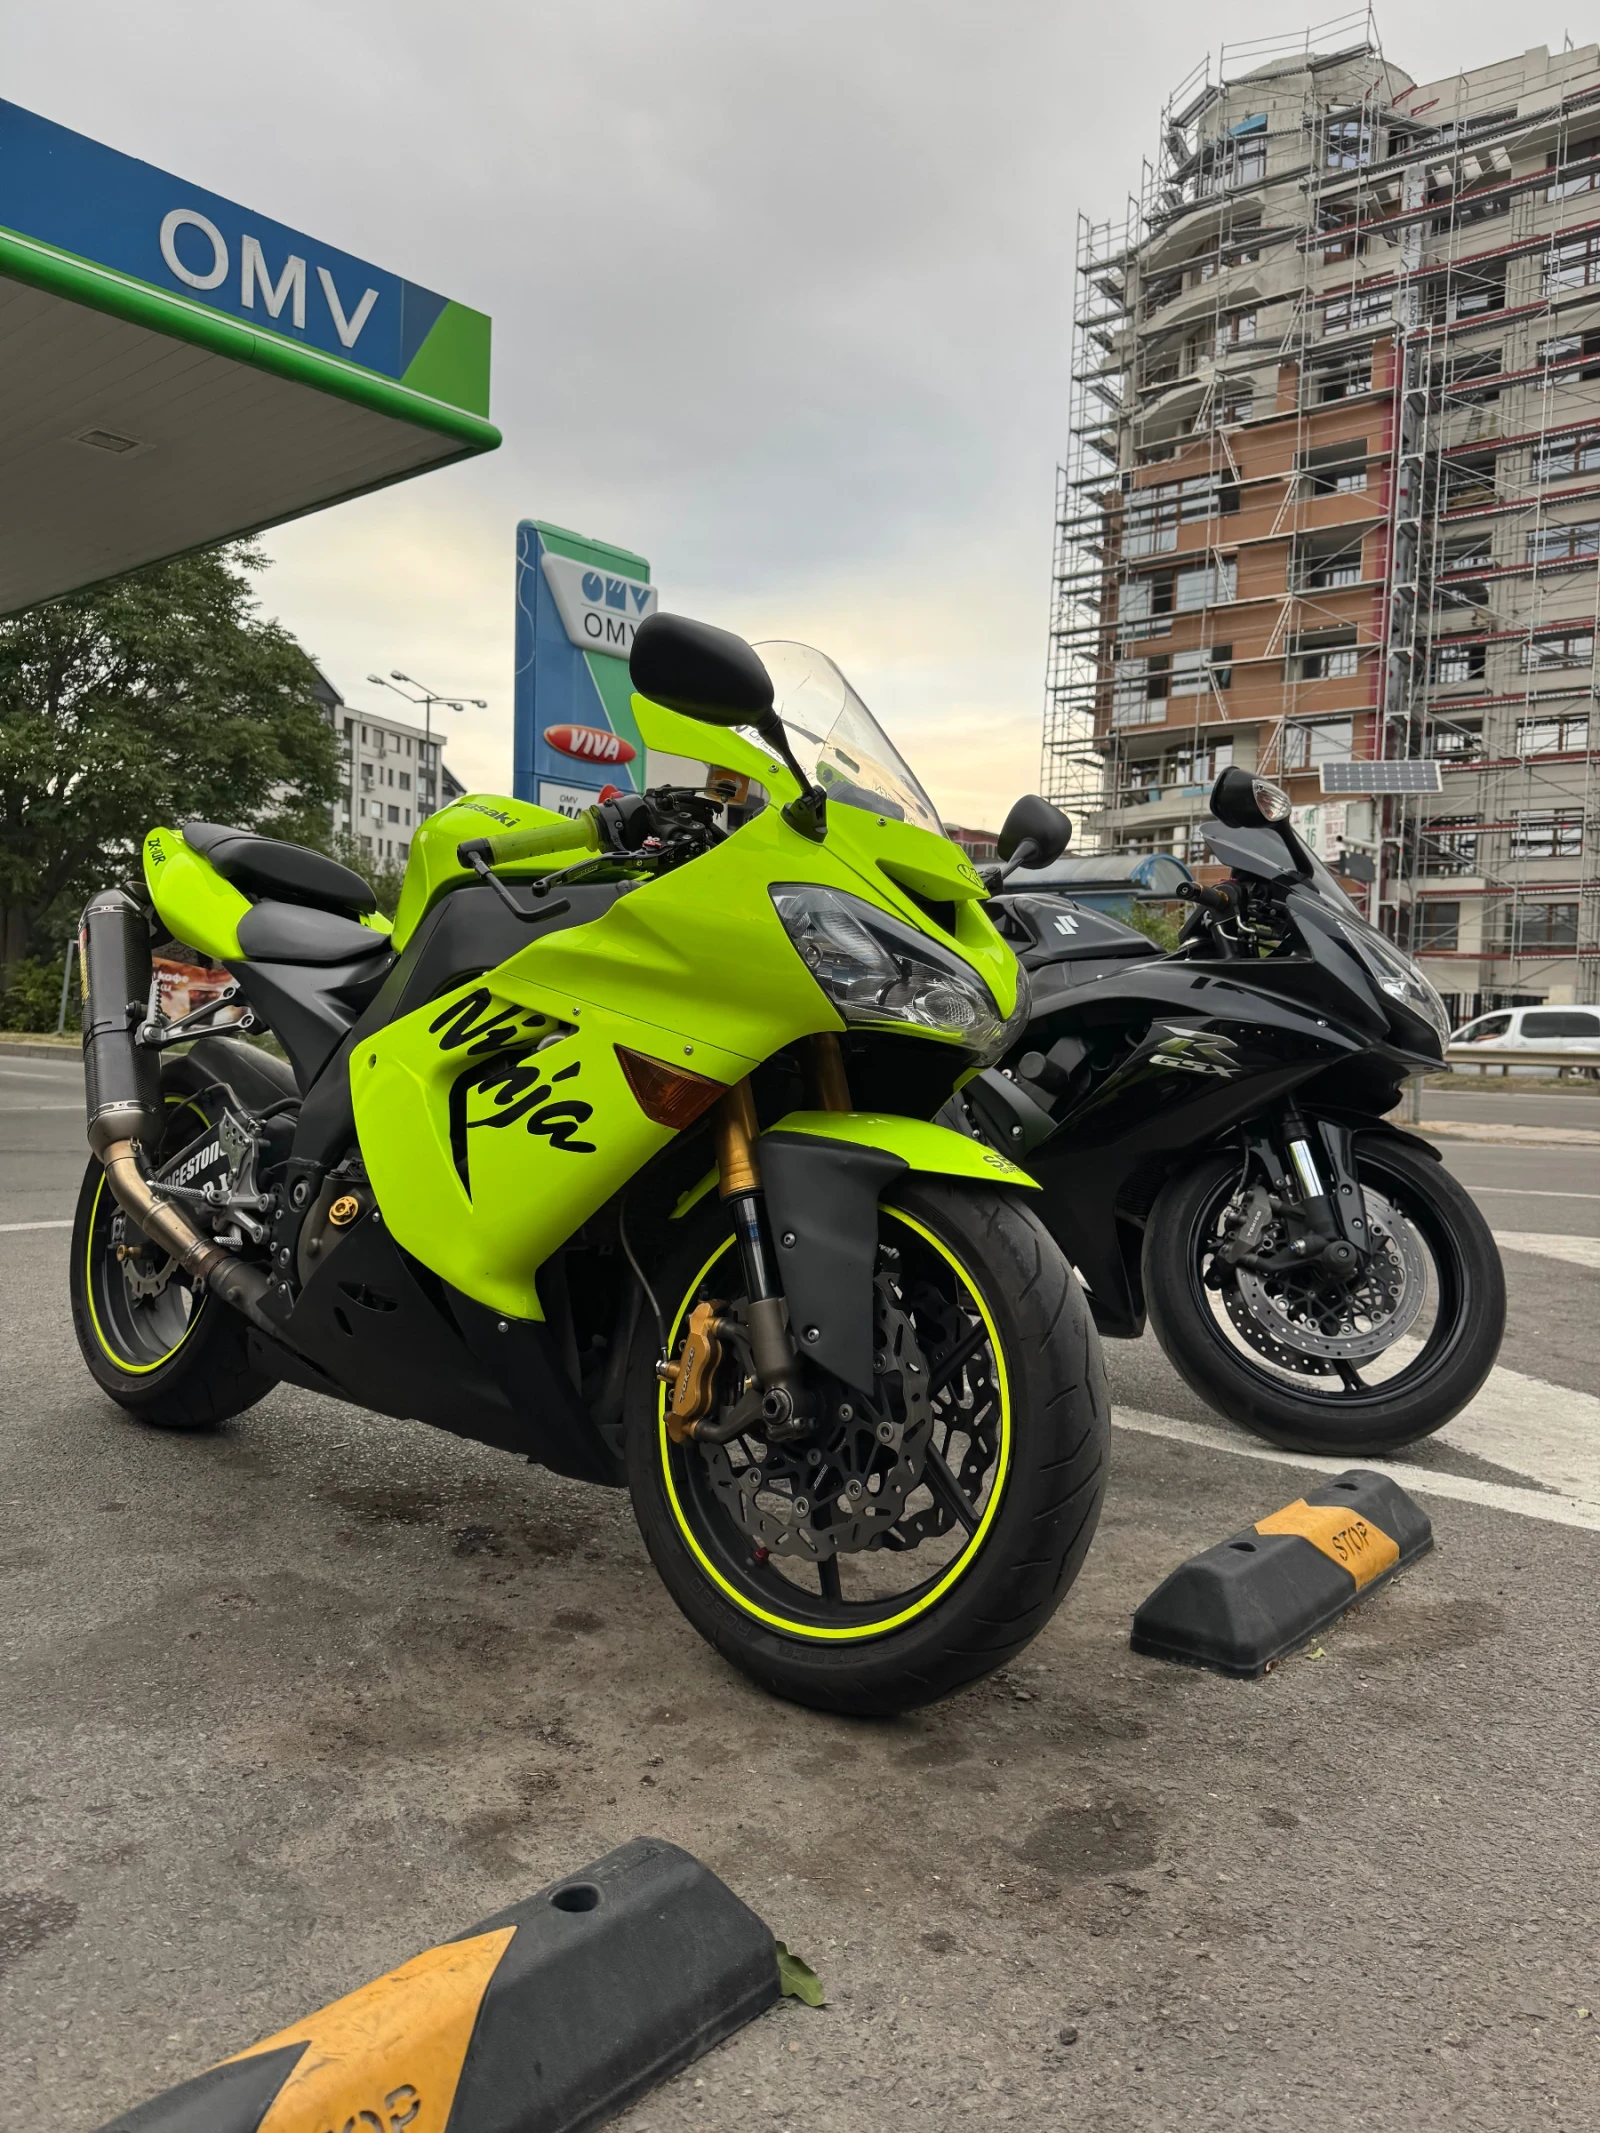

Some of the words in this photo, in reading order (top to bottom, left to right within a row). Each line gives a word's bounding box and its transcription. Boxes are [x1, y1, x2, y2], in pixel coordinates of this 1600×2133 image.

[159, 208, 379, 348] OMV
[569, 728, 620, 760] VIVA
[559, 794, 578, 805] OMV
[1305, 828, 1316, 848] 16
[428, 987, 597, 1153] Ninja
[1149, 1054, 1242, 1078] GSX
[1247, 1210, 1262, 1237] TOKICO
[680, 1347, 695, 1403] TOKICO
[1332, 1521, 1371, 1561] STOP
[688, 1575, 752, 1638] ROSSO
